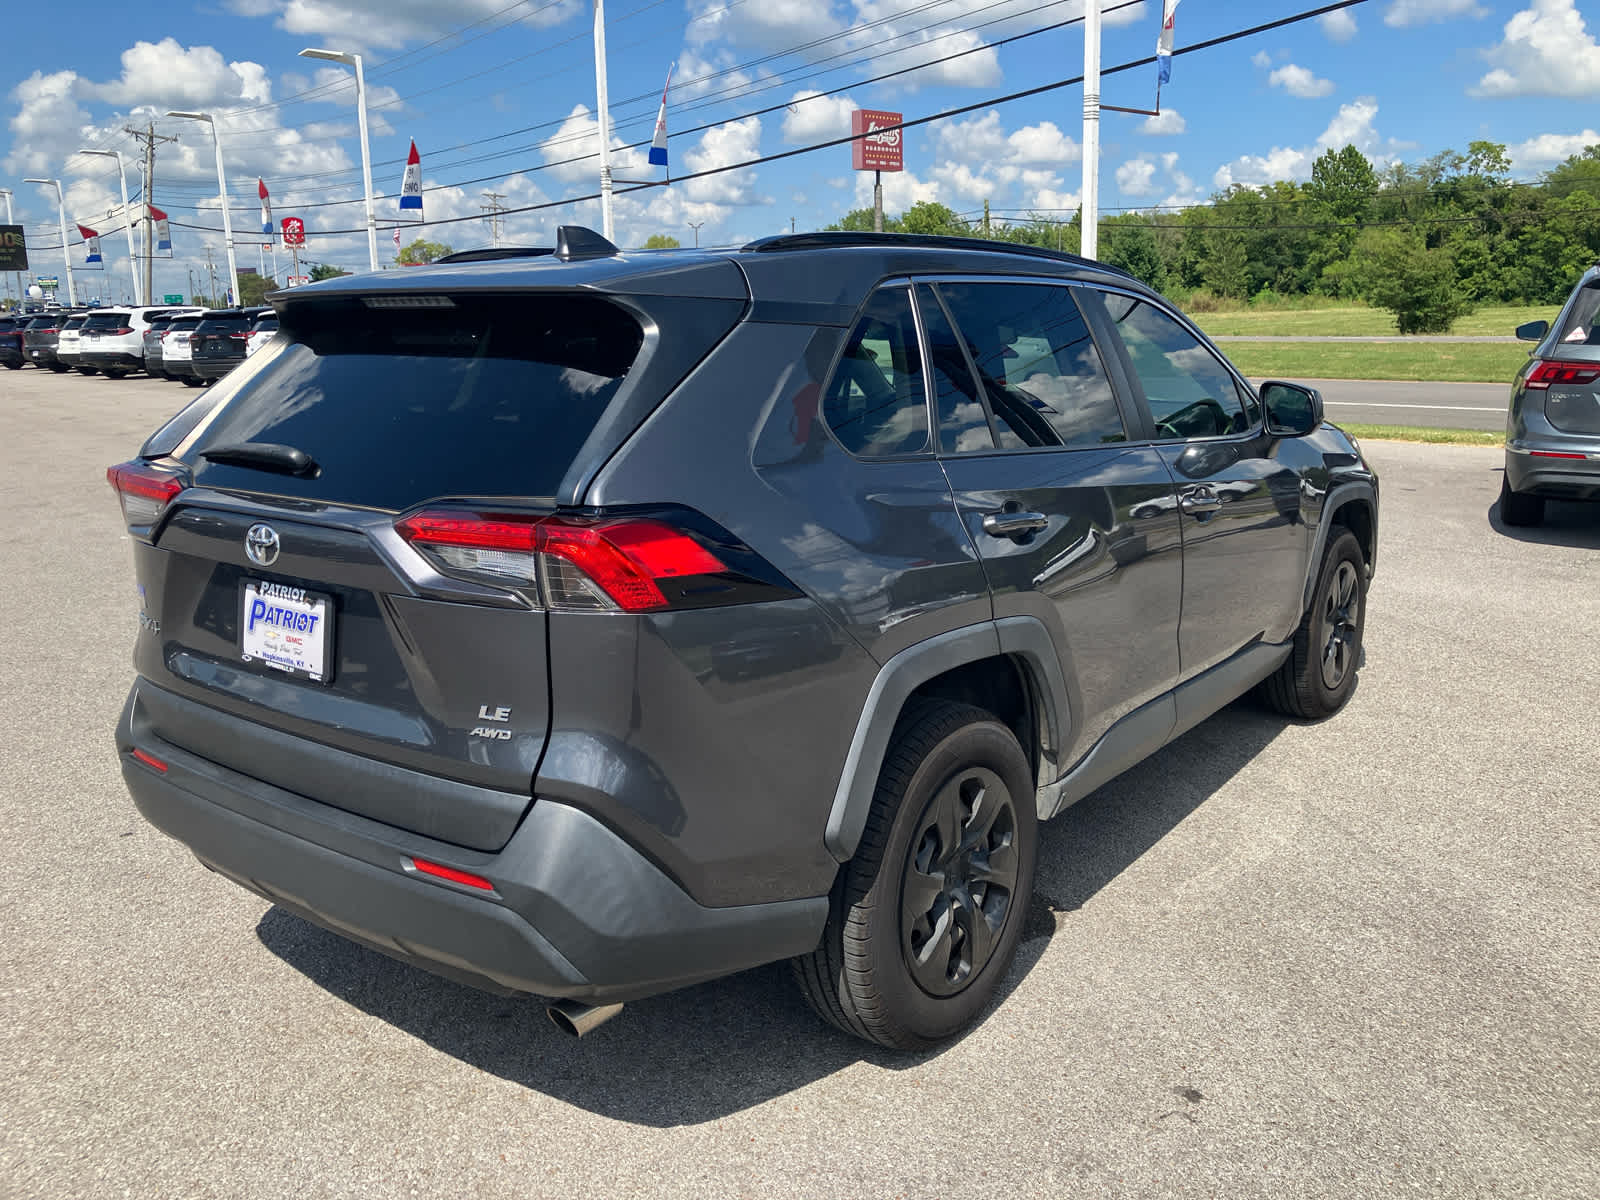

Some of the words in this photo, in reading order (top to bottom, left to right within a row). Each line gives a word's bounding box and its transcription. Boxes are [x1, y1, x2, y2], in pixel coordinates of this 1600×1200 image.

[261, 581, 306, 601] PATRIOT
[249, 599, 319, 633] PATRIOT
[286, 636, 303, 645] GMC
[296, 659, 305, 668] KY
[478, 705, 511, 721] LE
[469, 727, 512, 740] AWD
